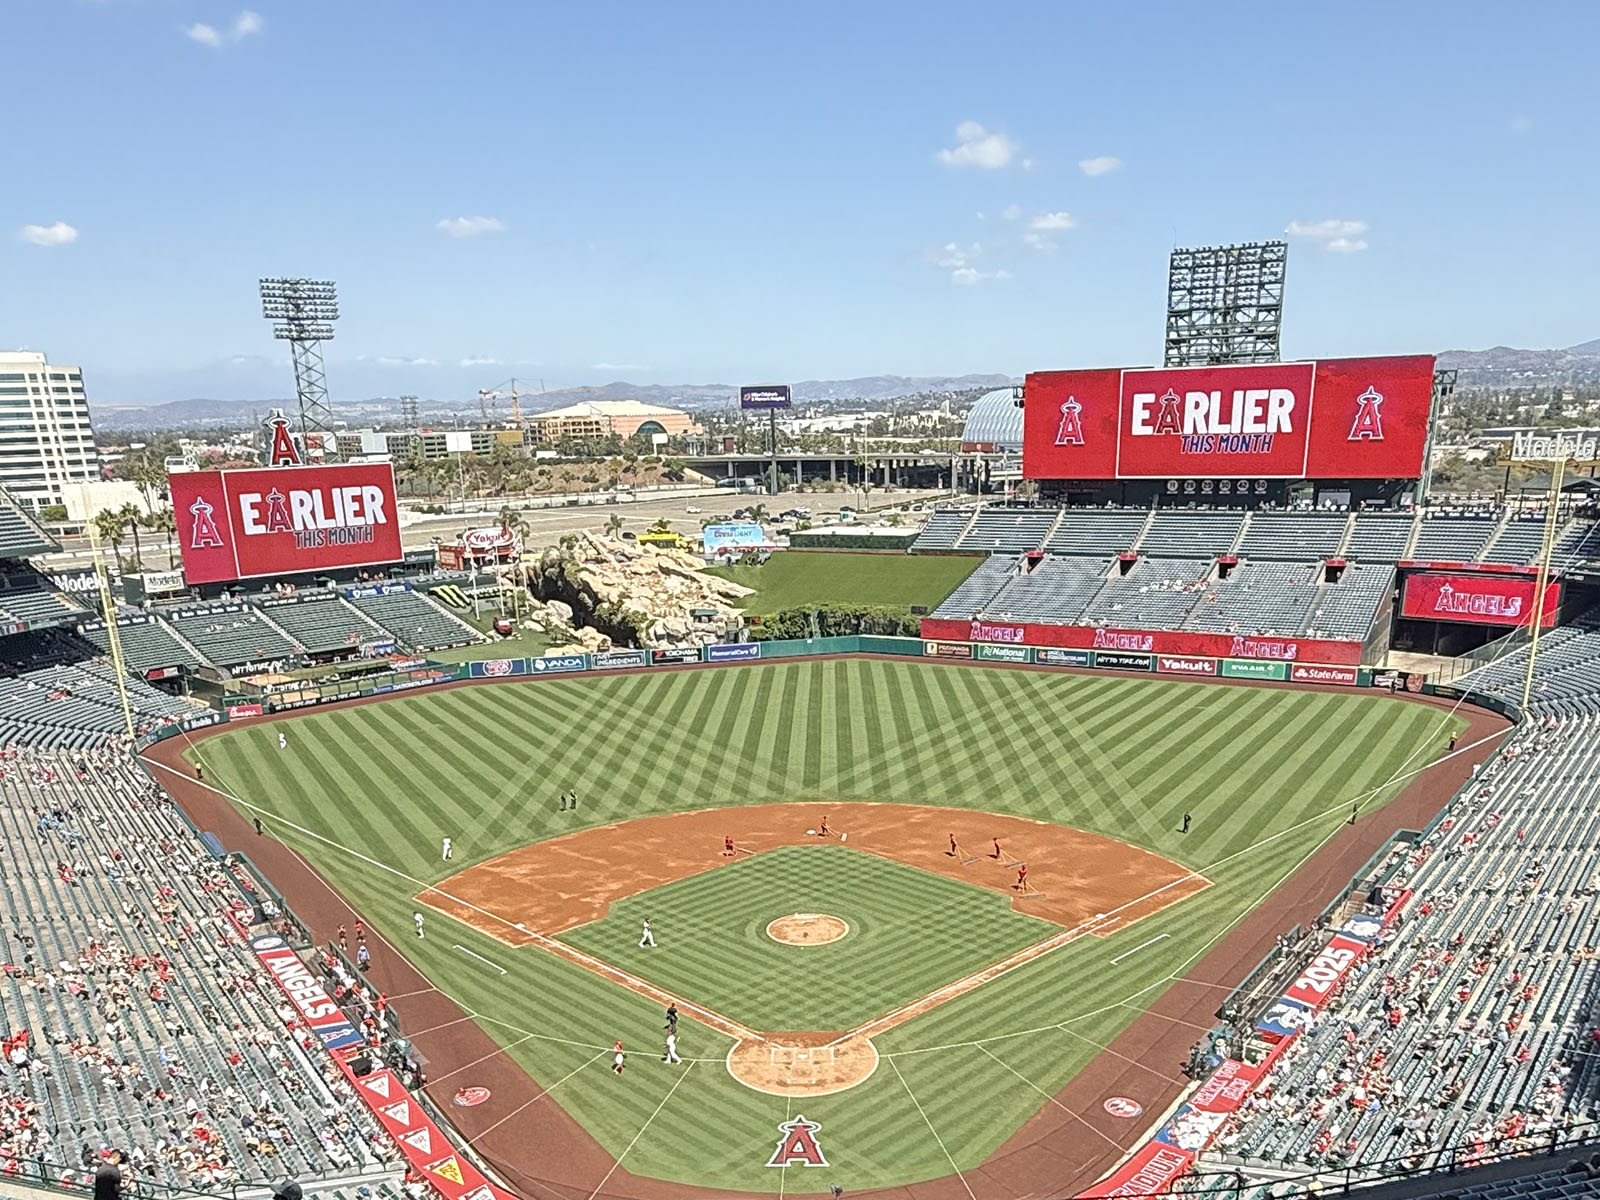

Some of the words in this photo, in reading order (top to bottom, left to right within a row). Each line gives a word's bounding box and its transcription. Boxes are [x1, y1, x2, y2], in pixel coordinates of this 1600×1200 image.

[1131, 388, 1295, 436] EARLIER
[1180, 434, 1214, 455] THIS
[1217, 432, 1275, 455] MONTH
[239, 486, 387, 535] EARLIER
[294, 529, 326, 549] THIS
[328, 525, 374, 546] MONTH
[474, 533, 508, 546] Yakul
[1434, 583, 1522, 617] ANGELS
[969, 621, 1025, 643] ANGELS
[1093, 628, 1154, 650] ANGELS
[665, 648, 699, 657] YOKOHAMA
[711, 649, 749, 657] MemorialCare
[992, 647, 1026, 657] National
[1229, 636, 1297, 660] ANGELS
[546, 658, 582, 666] VANDA
[1162, 660, 1213, 672] Yakult
[1295, 946, 1355, 995] 2025
[266, 956, 338, 1019] ANGELS
[764, 1113, 831, 1167] A
[1104, 1148, 1187, 1197] TADIUM
